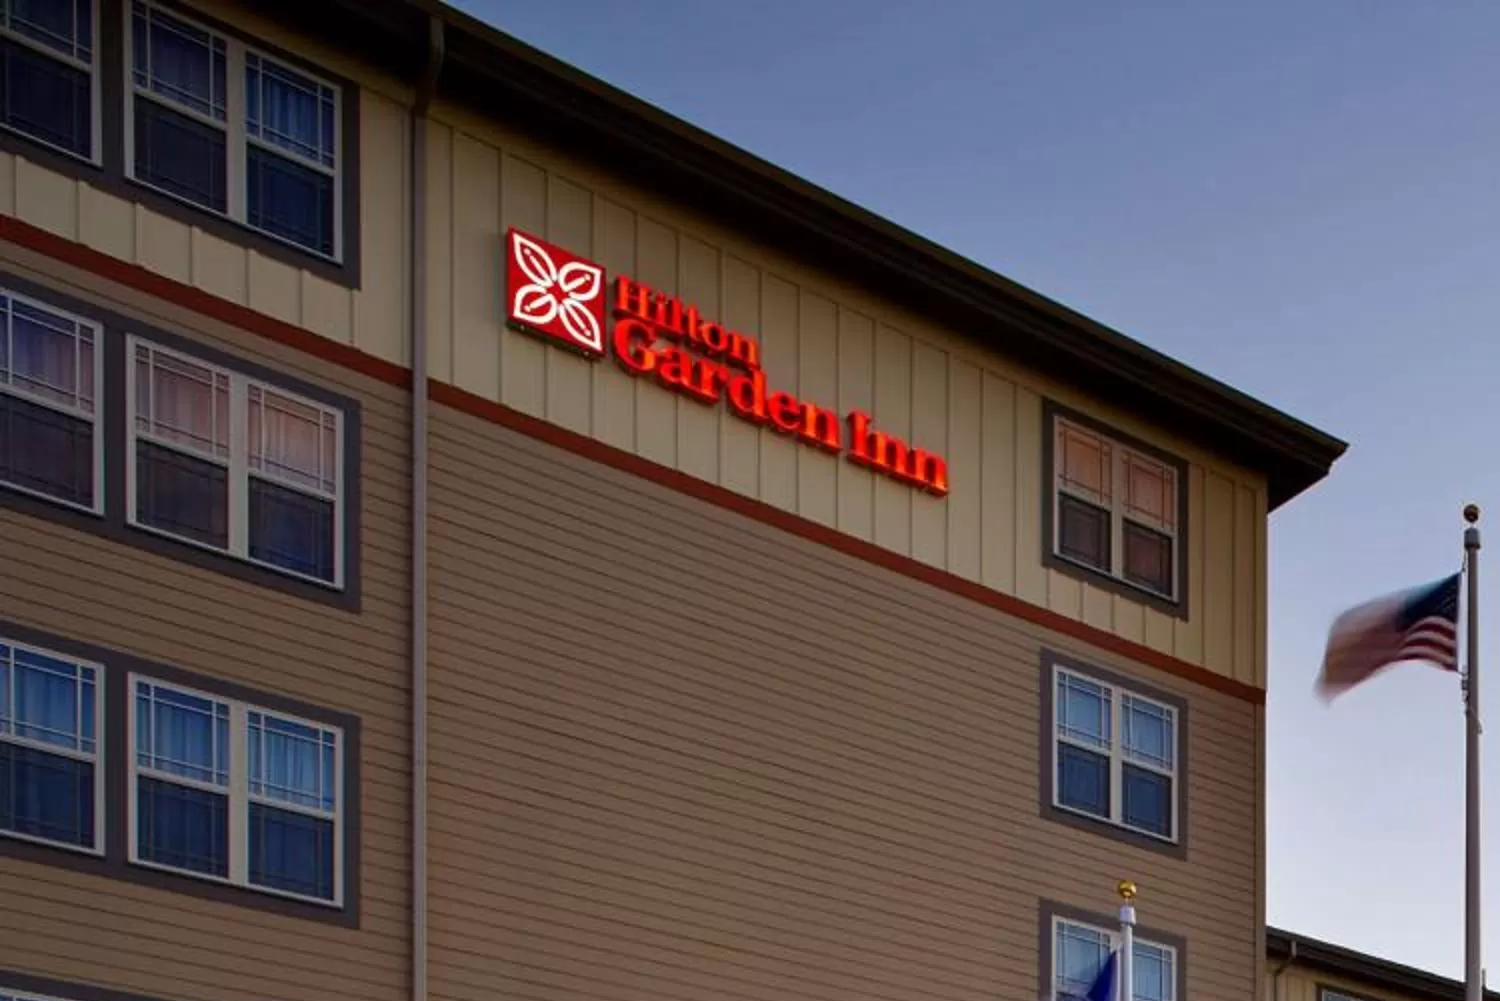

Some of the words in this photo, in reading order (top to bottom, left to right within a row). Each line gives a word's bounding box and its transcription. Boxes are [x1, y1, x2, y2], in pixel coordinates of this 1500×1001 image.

[613, 273, 761, 370] Hilton
[611, 317, 842, 454] Garden
[846, 409, 949, 496] Inn
